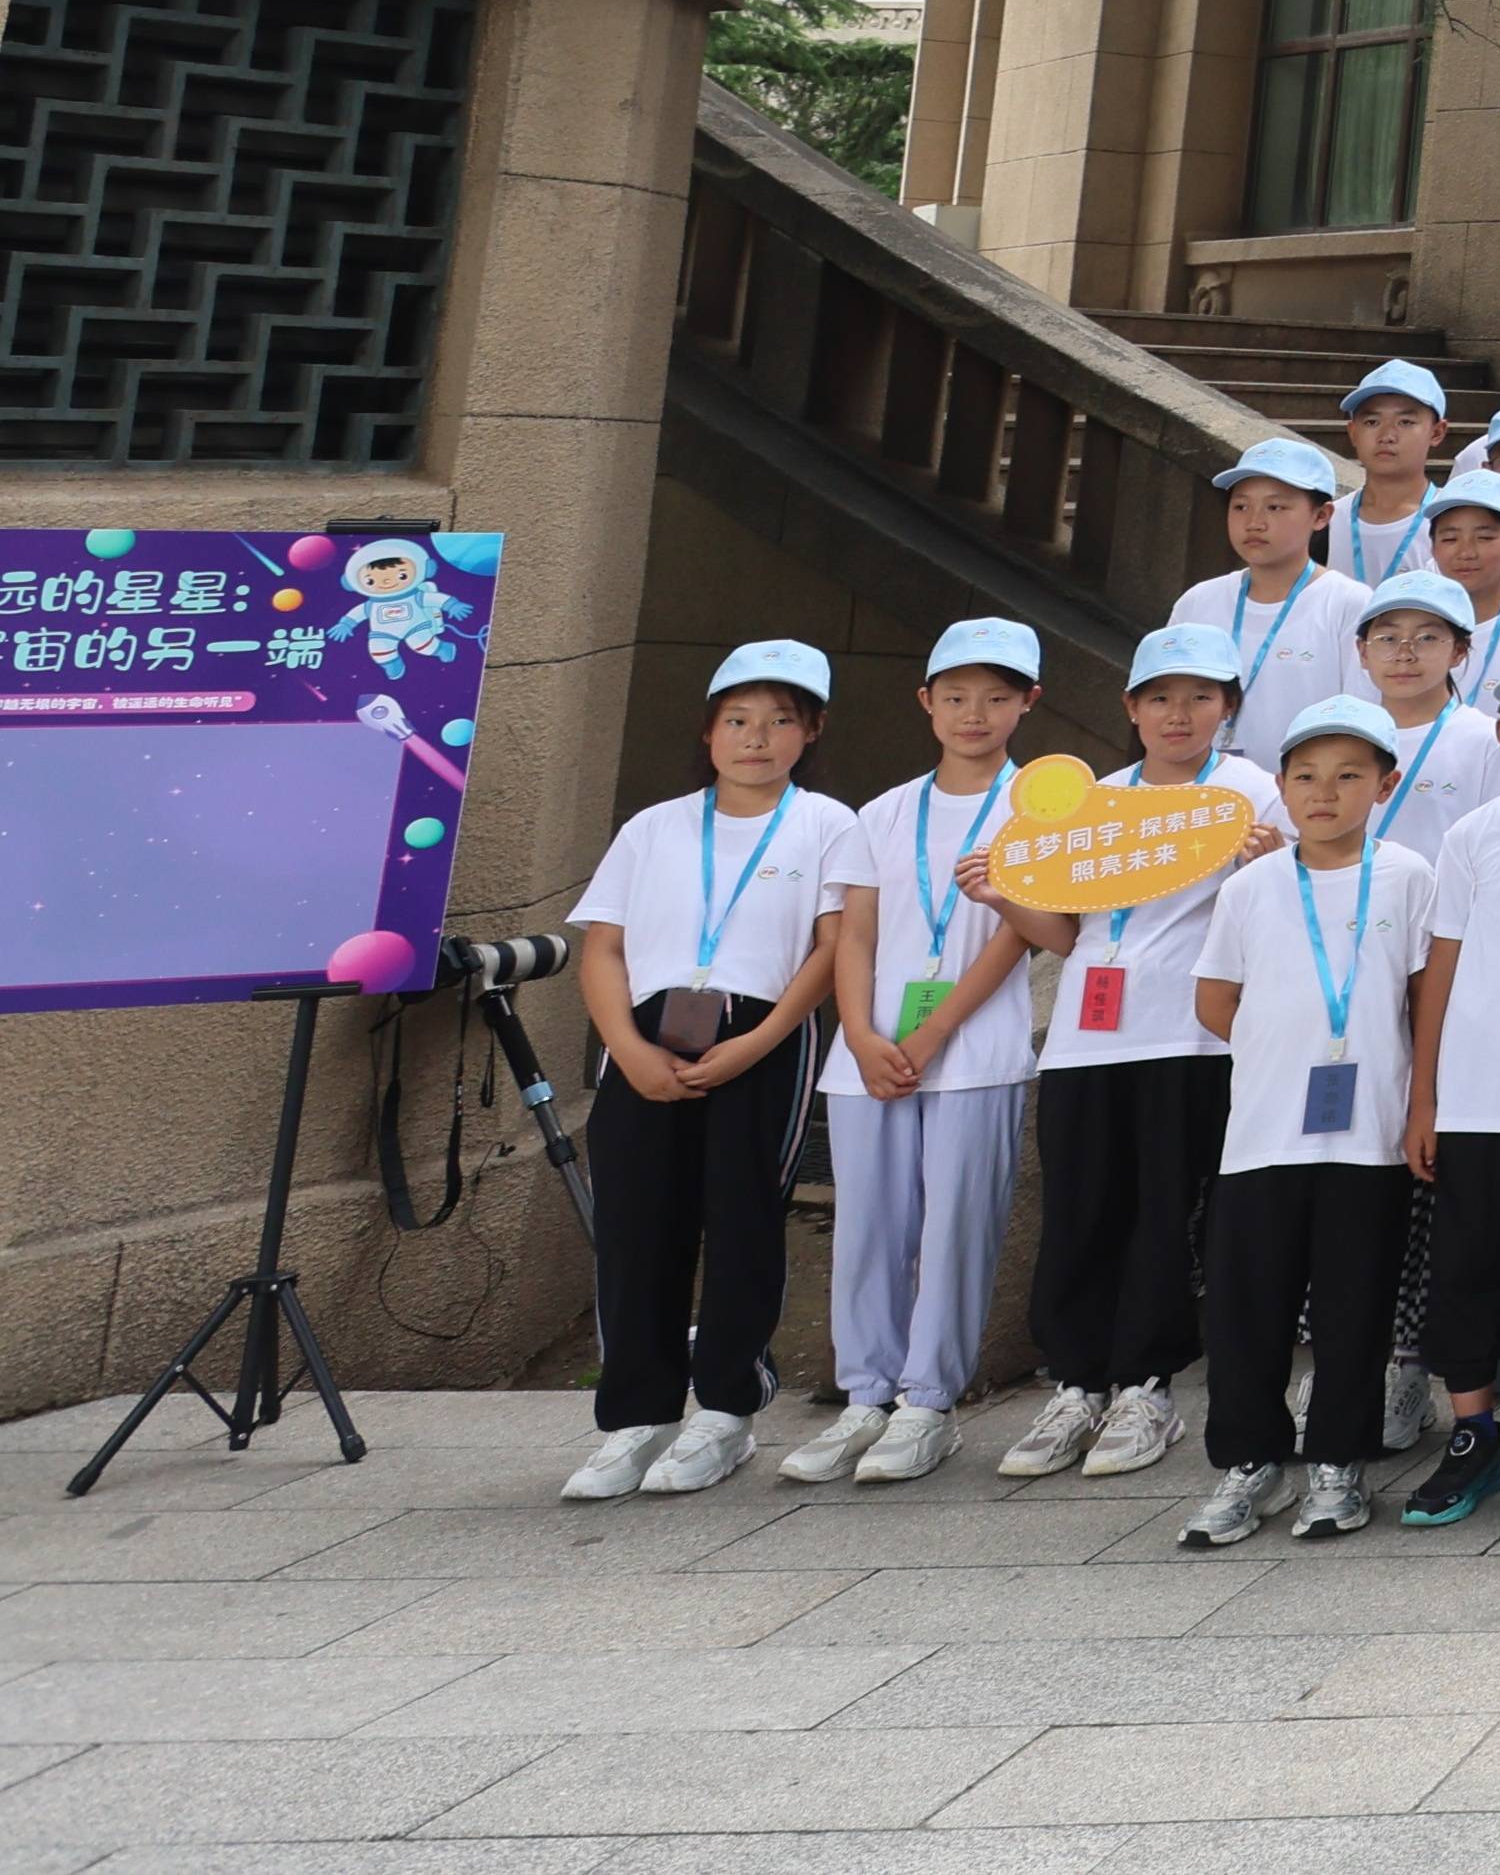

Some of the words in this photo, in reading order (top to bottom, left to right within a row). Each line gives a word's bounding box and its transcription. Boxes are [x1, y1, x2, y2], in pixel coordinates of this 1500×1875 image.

[0, 626, 326, 672] 宙的另一端
[1071, 843, 1178, 883] 照亮未来
[914, 989, 935, 1029] 王雨
